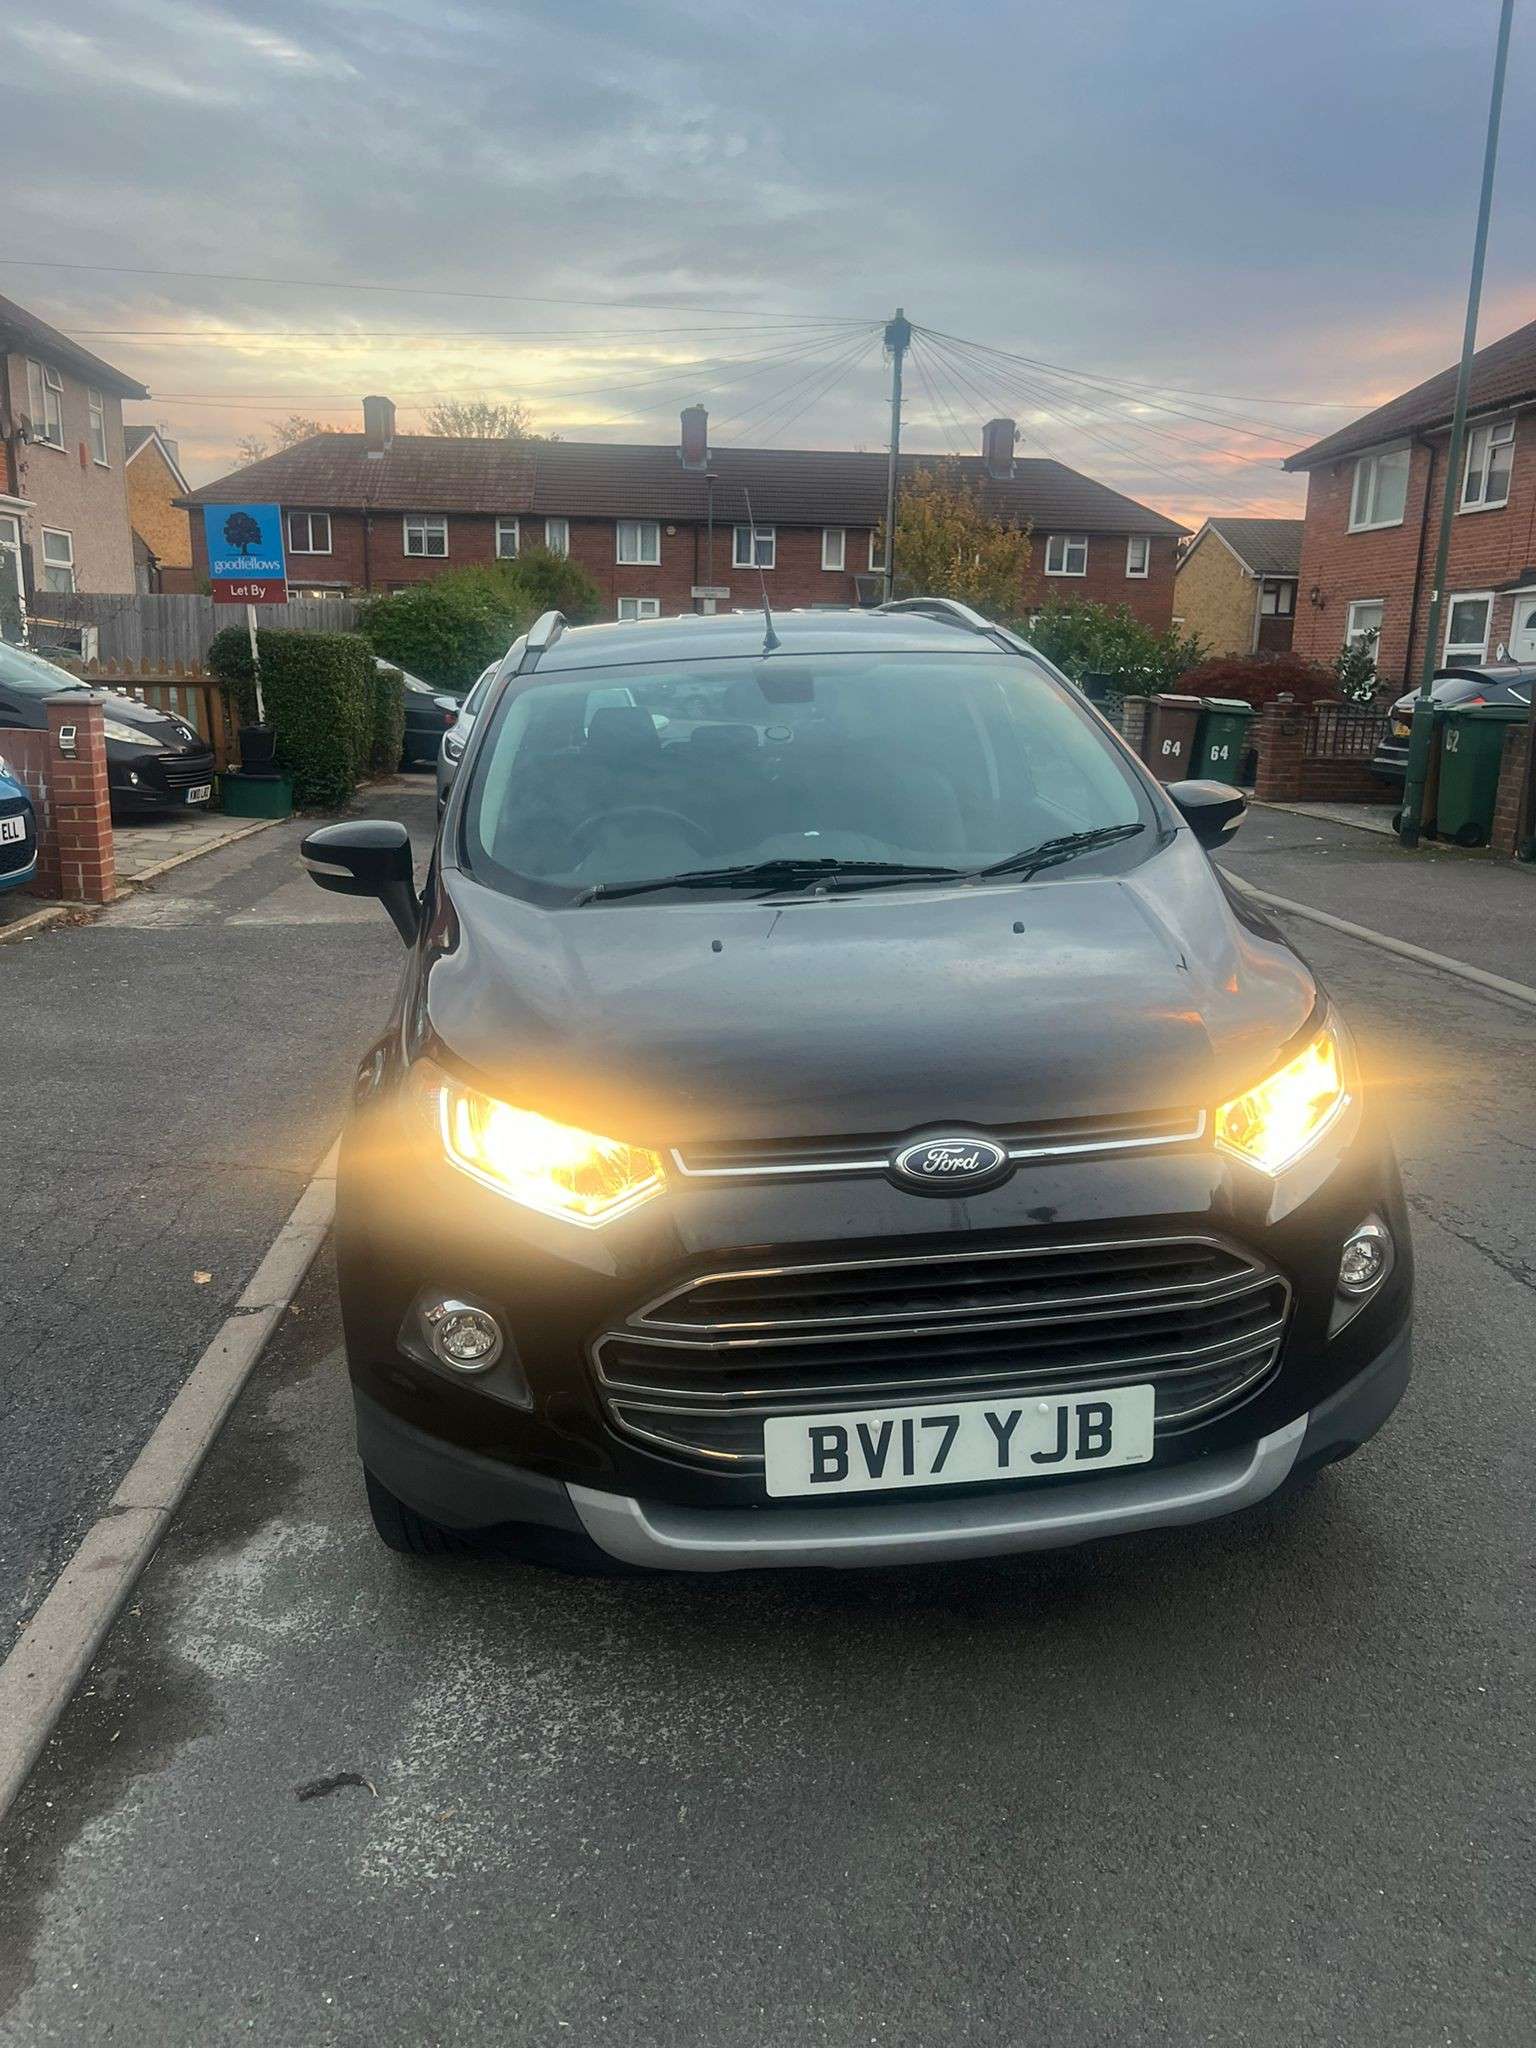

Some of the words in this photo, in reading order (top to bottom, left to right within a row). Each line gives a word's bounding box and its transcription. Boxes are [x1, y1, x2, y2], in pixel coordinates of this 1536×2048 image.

[214, 556, 280, 573] goodfellows
[230, 585, 248, 596] Let
[251, 584, 266, 598] By
[1162, 739, 1181, 757] 64
[1210, 745, 1229, 760] 64
[1, 821, 19, 841] ELL
[922, 1147, 979, 1173] Ford
[809, 1415, 960, 1484] BV17
[984, 1401, 1113, 1468] YJB
